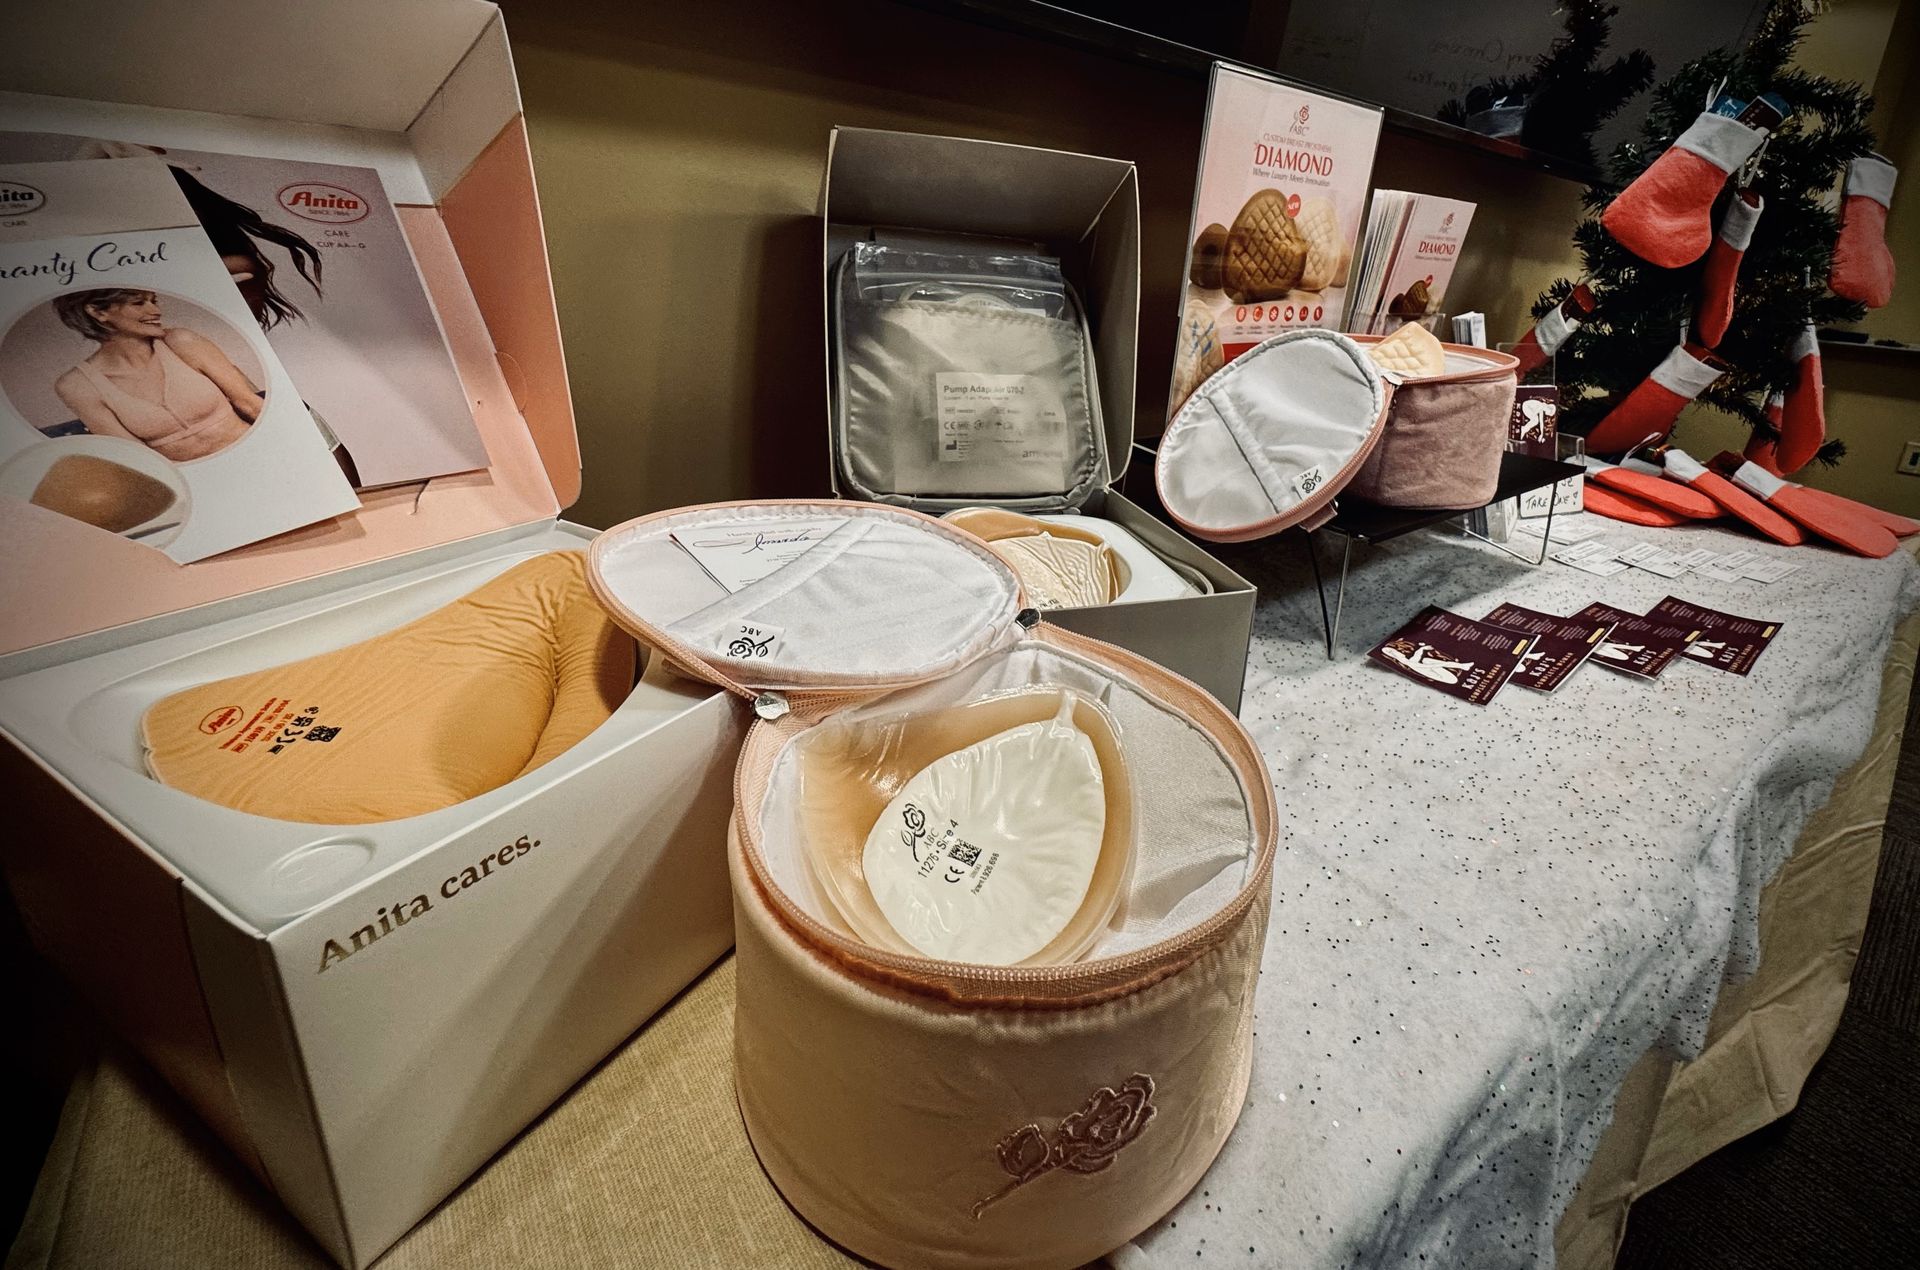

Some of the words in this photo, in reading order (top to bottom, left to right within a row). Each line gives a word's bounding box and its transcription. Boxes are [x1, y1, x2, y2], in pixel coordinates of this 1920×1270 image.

[1255, 144, 1333, 176] DIAMOND
[288, 192, 358, 210] Anita
[324, 230, 351, 238] CARE
[87, 242, 168, 272] Card
[943, 385, 968, 394] Pump
[1525, 498, 1547, 510] TAKE
[740, 625, 762, 637] ABC
[949, 818, 959, 829] 4
[923, 827, 939, 849] ABC
[944, 865, 965, 883] CE
[316, 894, 434, 974] Anita
[440, 834, 541, 899] cares.
